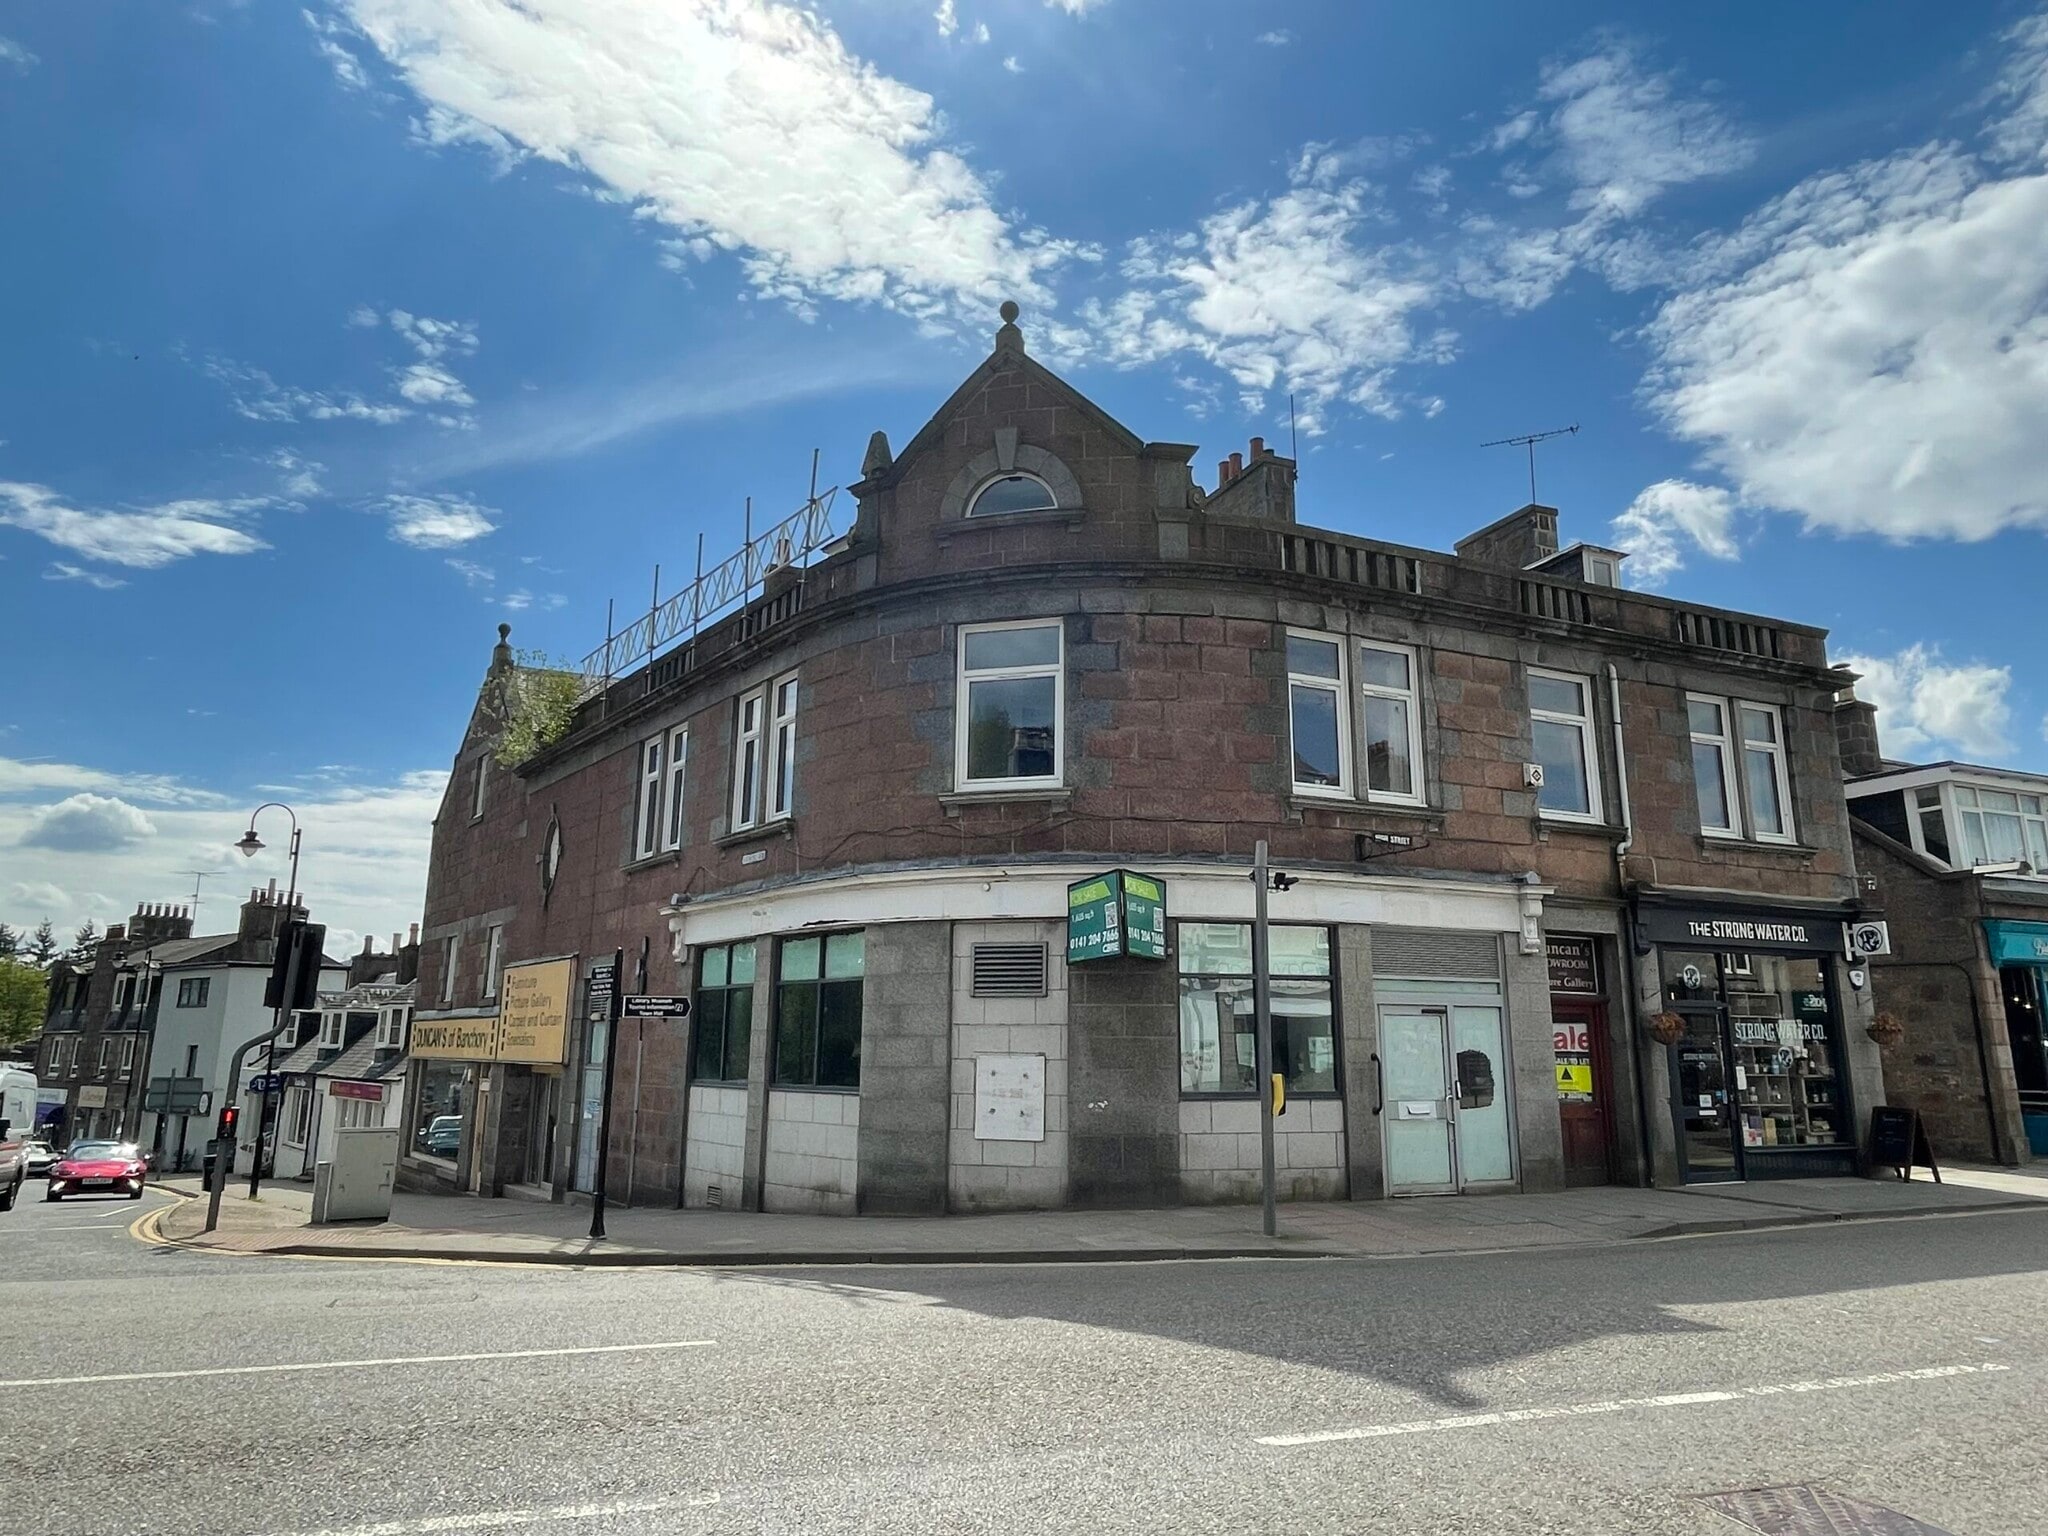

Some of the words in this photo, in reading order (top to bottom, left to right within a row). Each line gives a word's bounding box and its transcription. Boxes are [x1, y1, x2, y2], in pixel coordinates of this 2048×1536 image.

[1390, 835, 1410, 845] STREET
[1128, 927, 1140, 940] 0141
[1140, 930, 1151, 942] 204
[1688, 921, 1712, 937] THE
[1712, 920, 1754, 939] STRONG
[1754, 923, 1792, 941] WATER
[1791, 925, 1809, 943] CO.
[1070, 935, 1087, 949] 0141
[1088, 932, 1101, 946] 204
[1546, 943, 1590, 957] uncan's
[1548, 958, 1589, 969] OWROOM
[1563, 976, 1595, 990] Gallery
[1553, 1025, 1590, 1050] ale
[1735, 1022, 1777, 1041] STRONG
[1776, 1022, 1811, 1040] WATER
[1811, 1024, 1828, 1040] CO.
[416, 1027, 448, 1049] DUNCAN'S
[448, 1027, 457, 1048] of
[456, 1027, 488, 1053] Banchory
